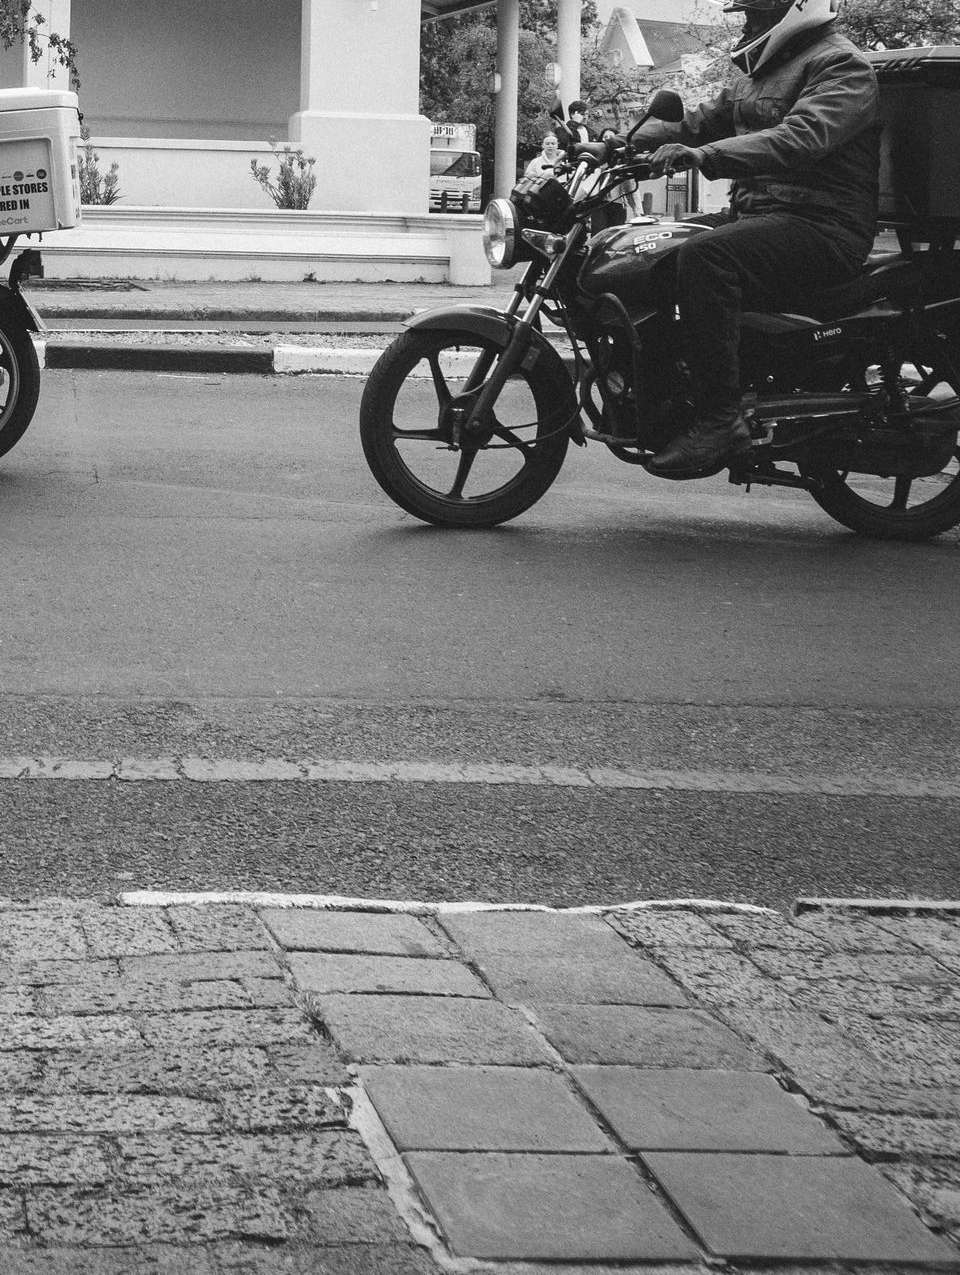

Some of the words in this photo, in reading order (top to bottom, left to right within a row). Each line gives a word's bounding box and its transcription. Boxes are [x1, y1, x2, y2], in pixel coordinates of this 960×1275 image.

[13, 181, 48, 196] STORES
[19, 198, 30, 210] IN
[633, 231, 673, 245] ECO
[634, 242, 656, 254] 150
[822, 327, 842, 337] Hero
